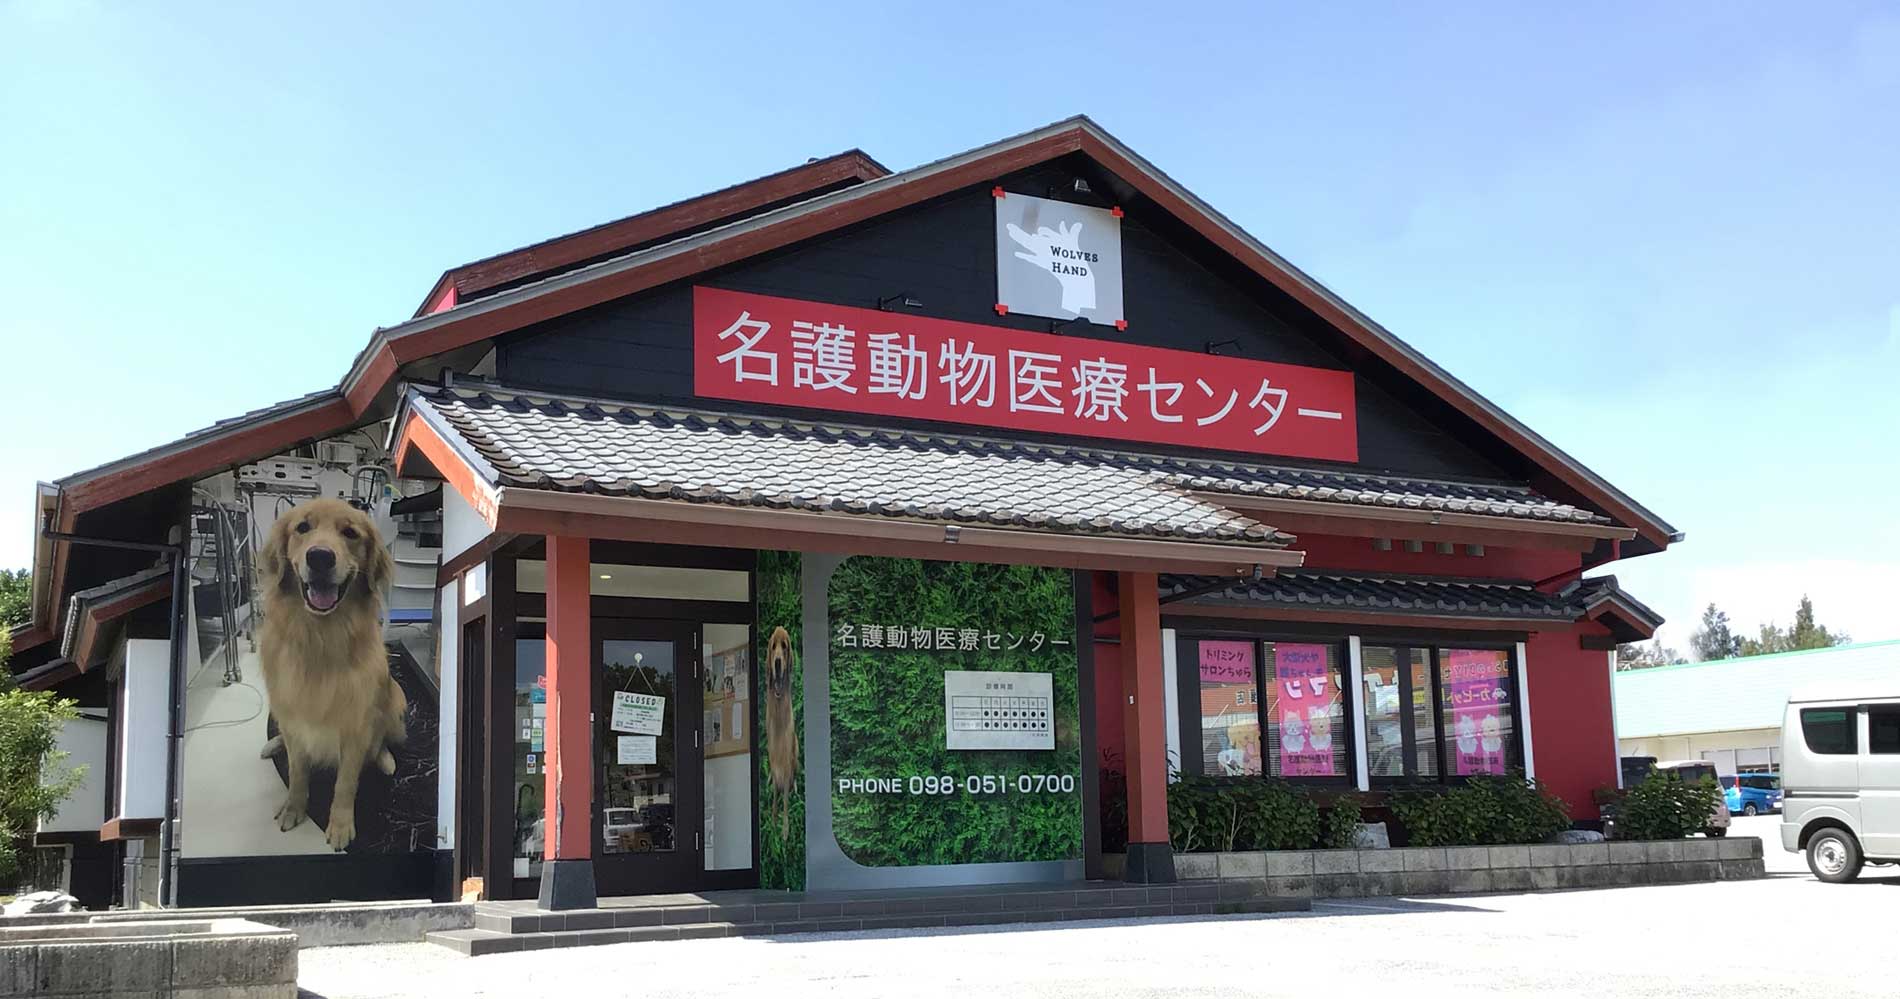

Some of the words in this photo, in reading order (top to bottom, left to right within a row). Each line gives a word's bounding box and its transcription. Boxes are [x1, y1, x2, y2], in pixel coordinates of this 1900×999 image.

[1050, 245, 1099, 262] WOLVES
[1052, 262, 1088, 276] HAND
[716, 310, 1343, 436] 名護動物医療センター
[836, 623, 1070, 652] 名護動物医療センター
[625, 694, 657, 706] CLOSED
[839, 778, 902, 794] PHONE
[909, 774, 1075, 796] 098-051-0700
